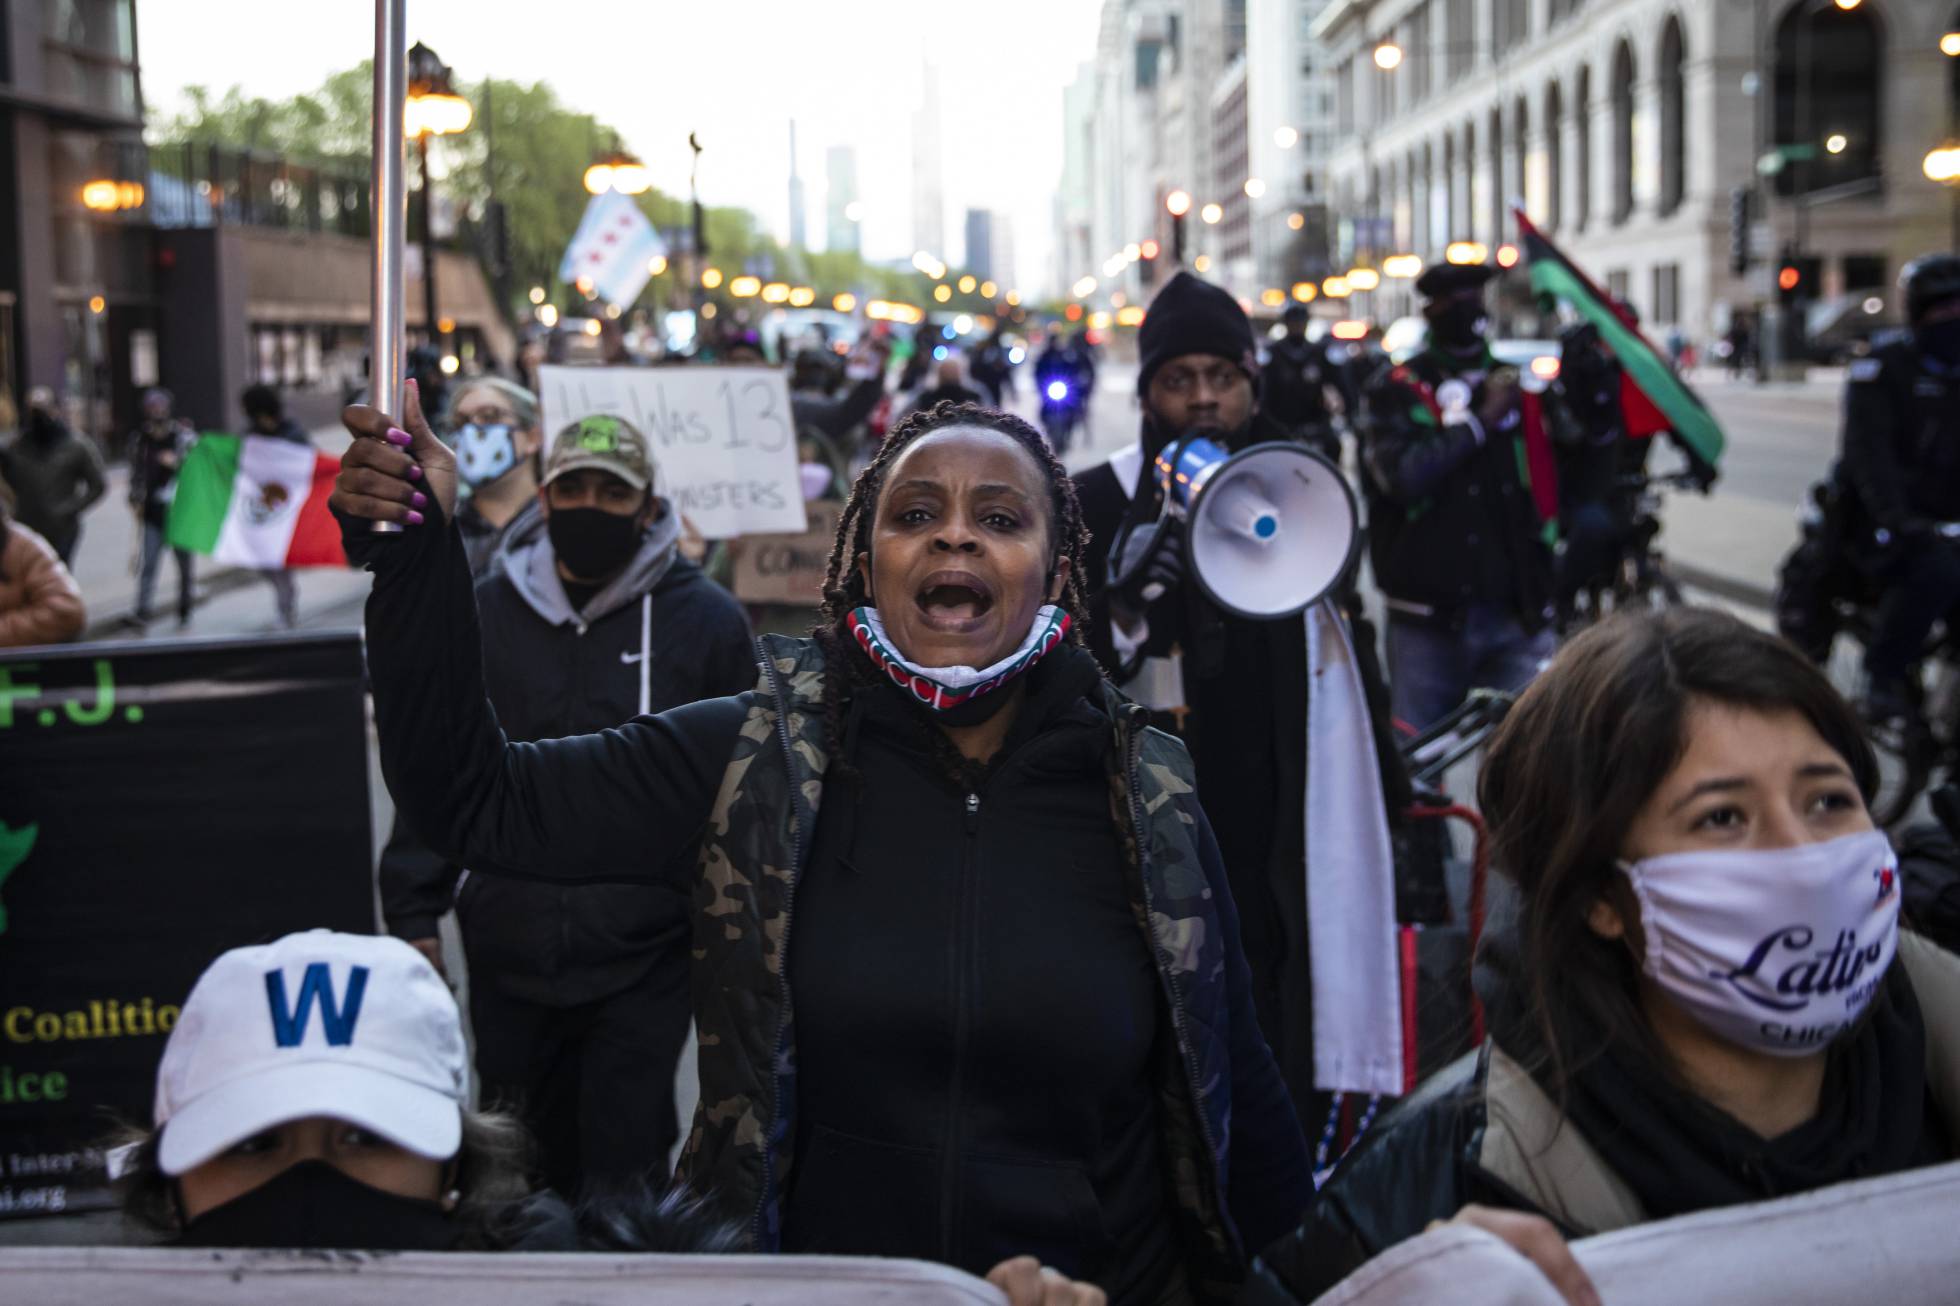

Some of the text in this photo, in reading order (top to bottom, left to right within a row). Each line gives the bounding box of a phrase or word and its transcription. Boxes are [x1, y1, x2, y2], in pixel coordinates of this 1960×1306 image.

[716, 377, 789, 452] 13
[853, 623, 944, 710] GUCCI
[4, 997, 181, 1043] Coalitio
[264, 962, 370, 1048] W
